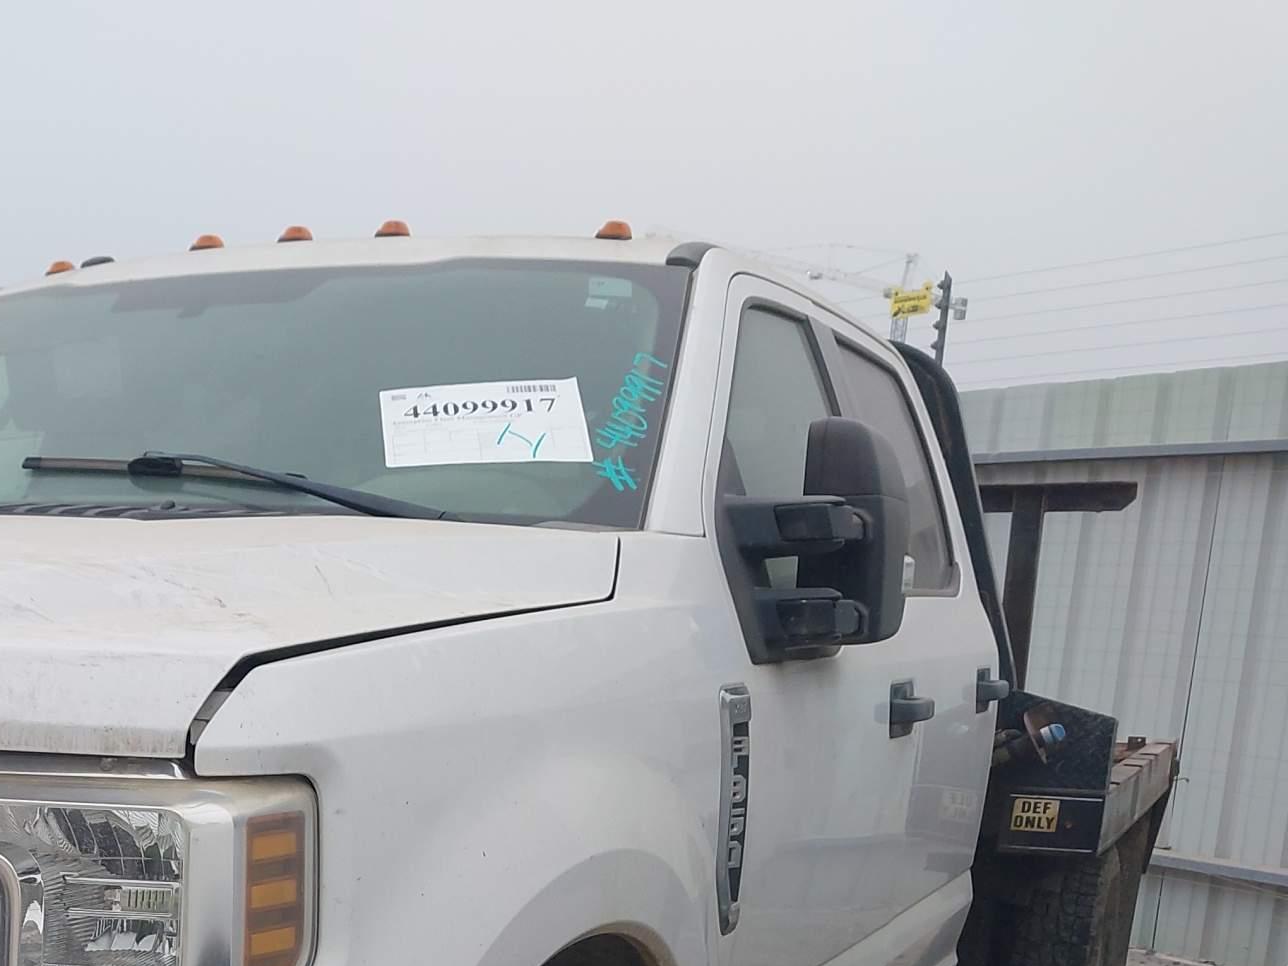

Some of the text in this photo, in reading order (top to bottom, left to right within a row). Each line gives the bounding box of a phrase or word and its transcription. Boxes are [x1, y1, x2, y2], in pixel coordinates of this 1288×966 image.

[403, 398, 556, 419] 44099917
[1021, 800, 1052, 815] DEF
[1013, 815, 1055, 830] ONLY
